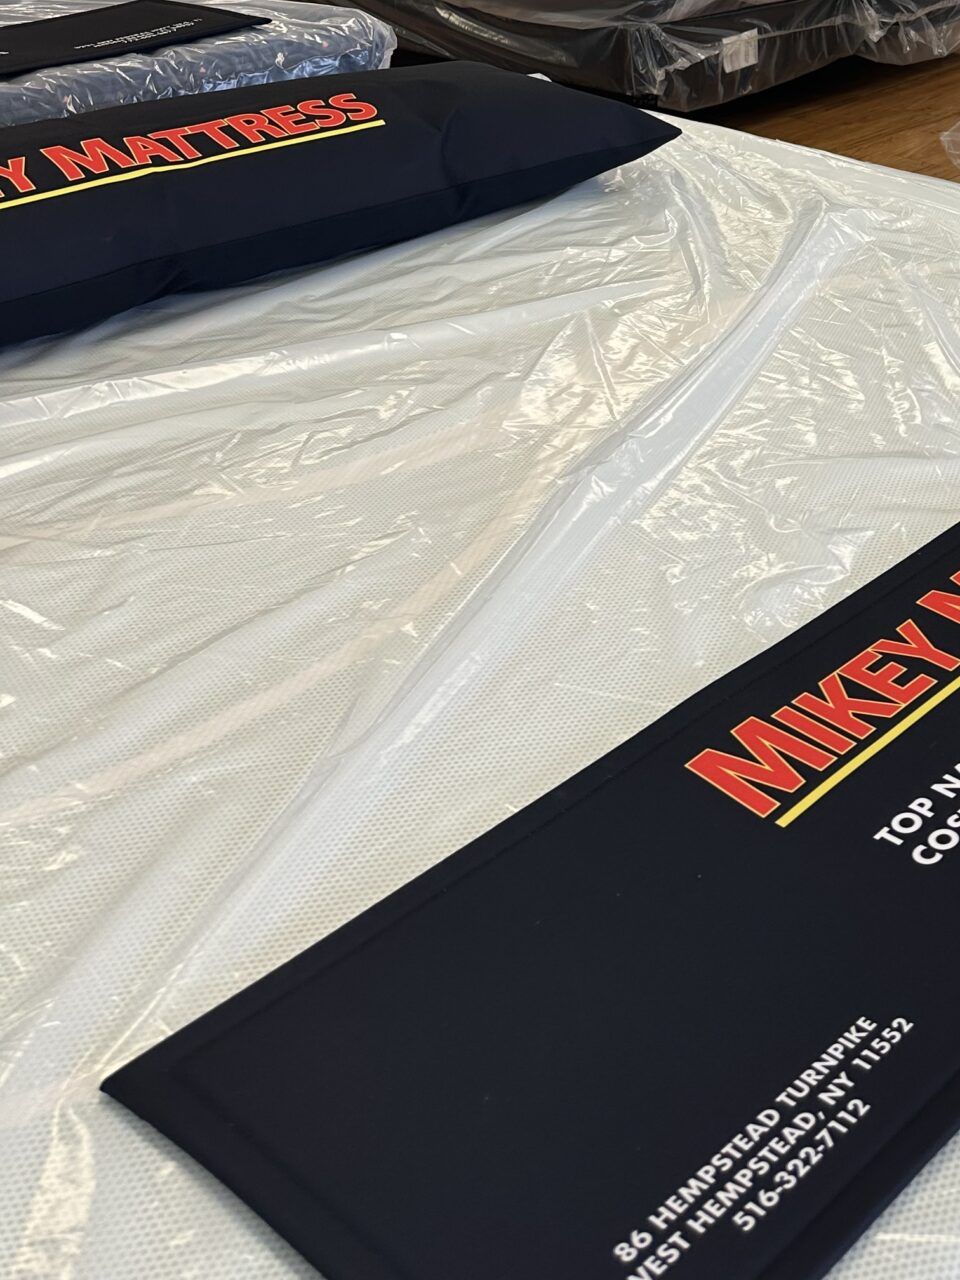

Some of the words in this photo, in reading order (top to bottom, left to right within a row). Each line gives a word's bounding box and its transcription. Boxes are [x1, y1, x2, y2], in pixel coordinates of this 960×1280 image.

[40, 92, 378, 181] MATTRESS
[873, 797, 935, 846] TOP
[613, 1229, 653, 1262] 86
[648, 1107, 780, 1230] HEMPSTEAD
[775, 1016, 878, 1107] TURNPIKE
[686, 1111, 826, 1234] HEMPSTEAD,
[817, 1070, 855, 1106] NY
[852, 1017, 914, 1071] 11552
[732, 1098, 871, 1231] 516-322-7112
